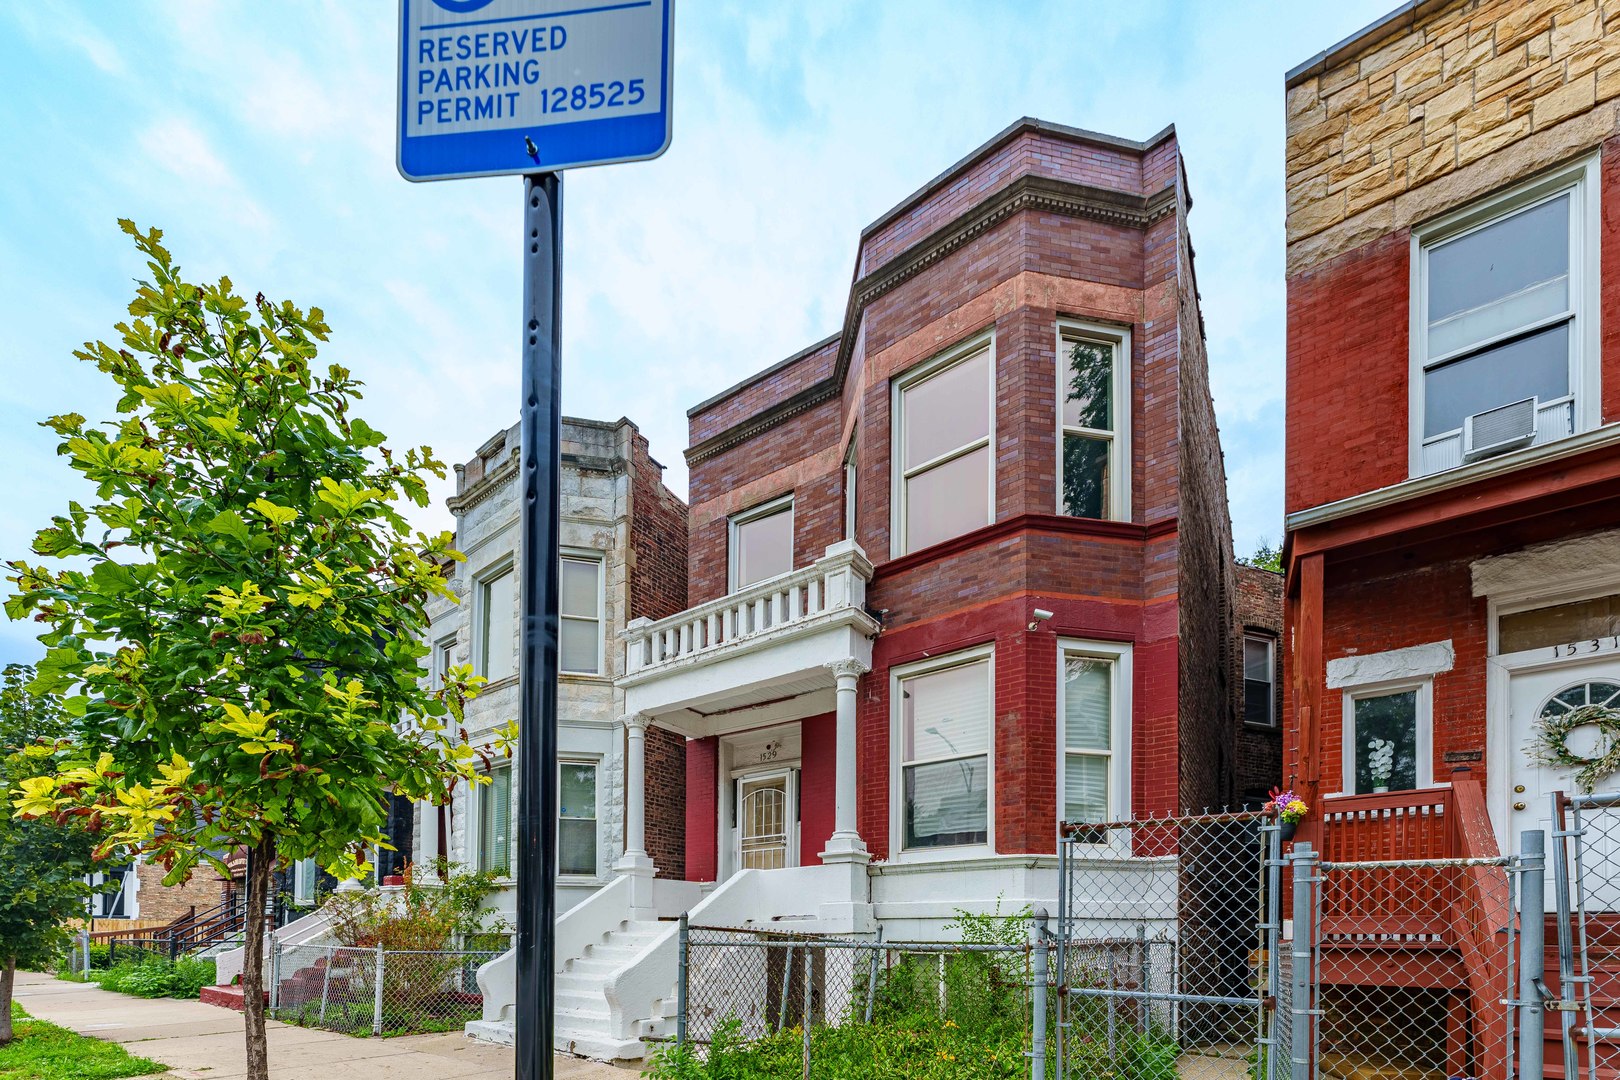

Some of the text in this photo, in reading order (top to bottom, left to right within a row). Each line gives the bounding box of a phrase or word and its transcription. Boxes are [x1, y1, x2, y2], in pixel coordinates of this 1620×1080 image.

[419, 25, 567, 63] RESERVED
[418, 59, 540, 94] PARKING
[417, 79, 645, 125] PERMIT 128525
[1554, 635, 1618, 658] 1531
[760, 750, 777, 761] 1529
